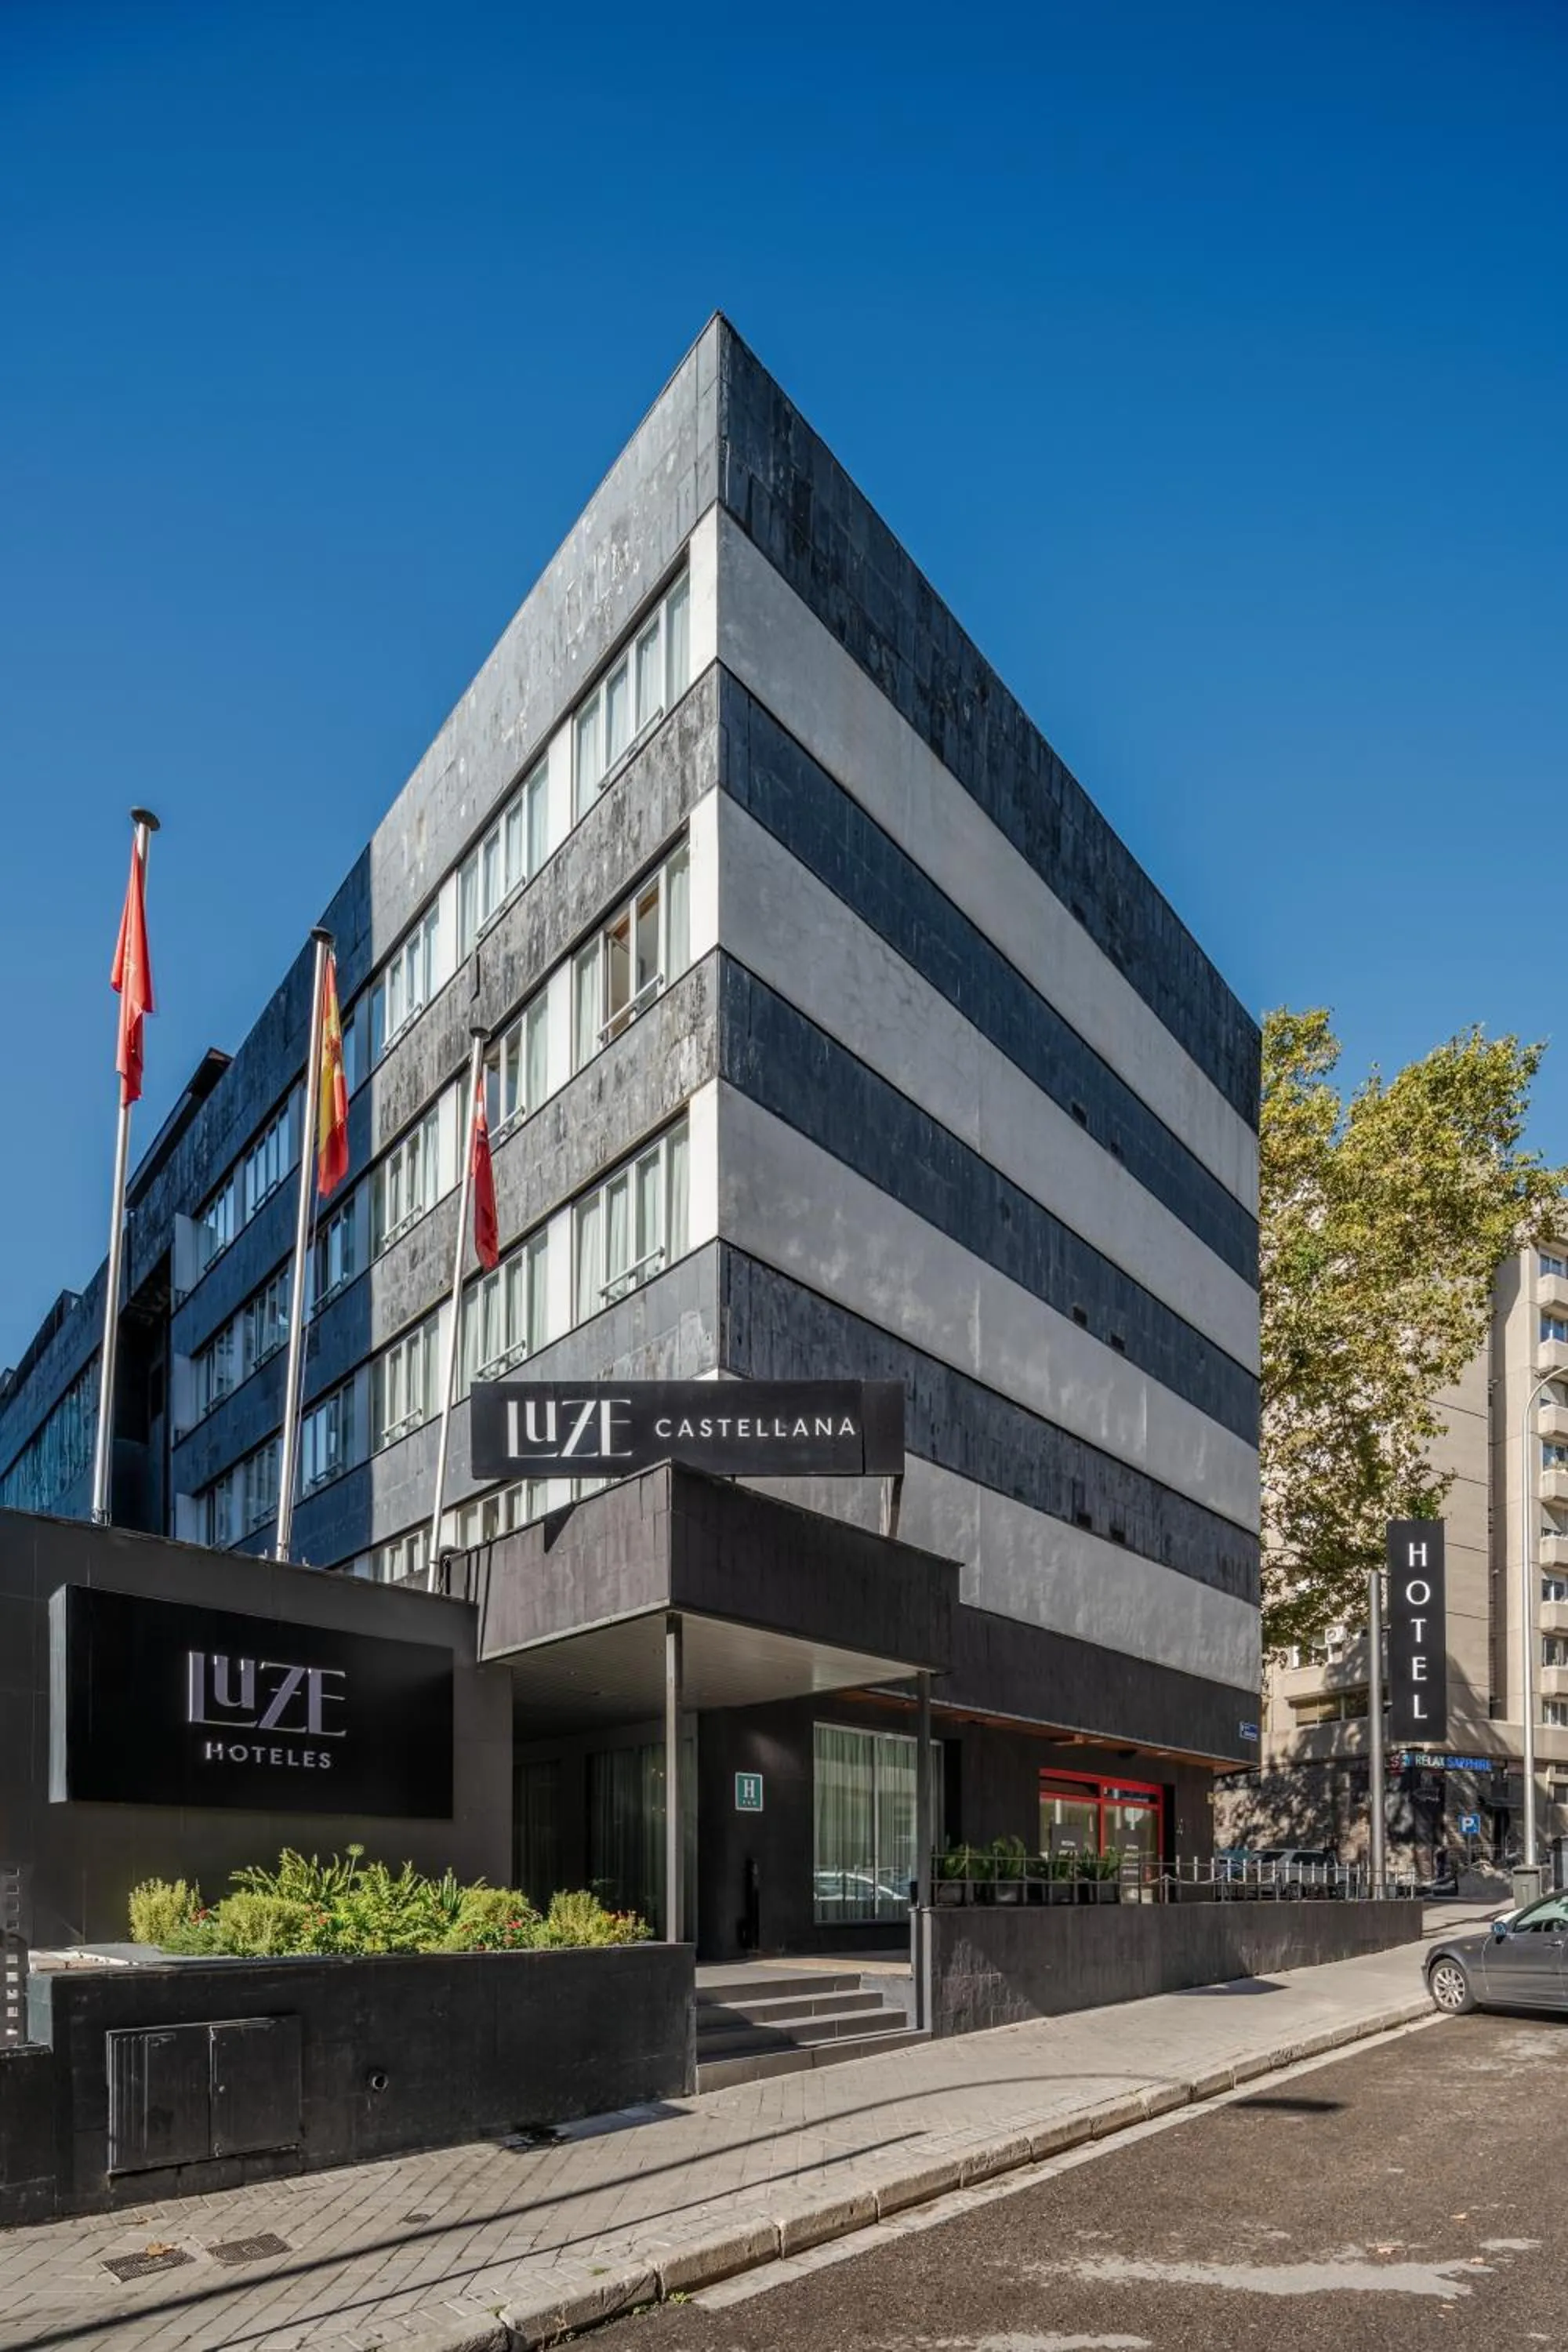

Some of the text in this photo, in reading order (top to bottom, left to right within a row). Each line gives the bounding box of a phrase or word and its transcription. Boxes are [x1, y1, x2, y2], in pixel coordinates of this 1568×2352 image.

[655, 1417, 856, 1438] CASTELLANA
[1406, 1542, 1431, 1719] HOTEL
[205, 1741, 332, 1769] HOTELES
[1415, 1755, 1445, 1768] RELAX
[743, 1779, 755, 1798] H
[1461, 1817, 1475, 1832] P
